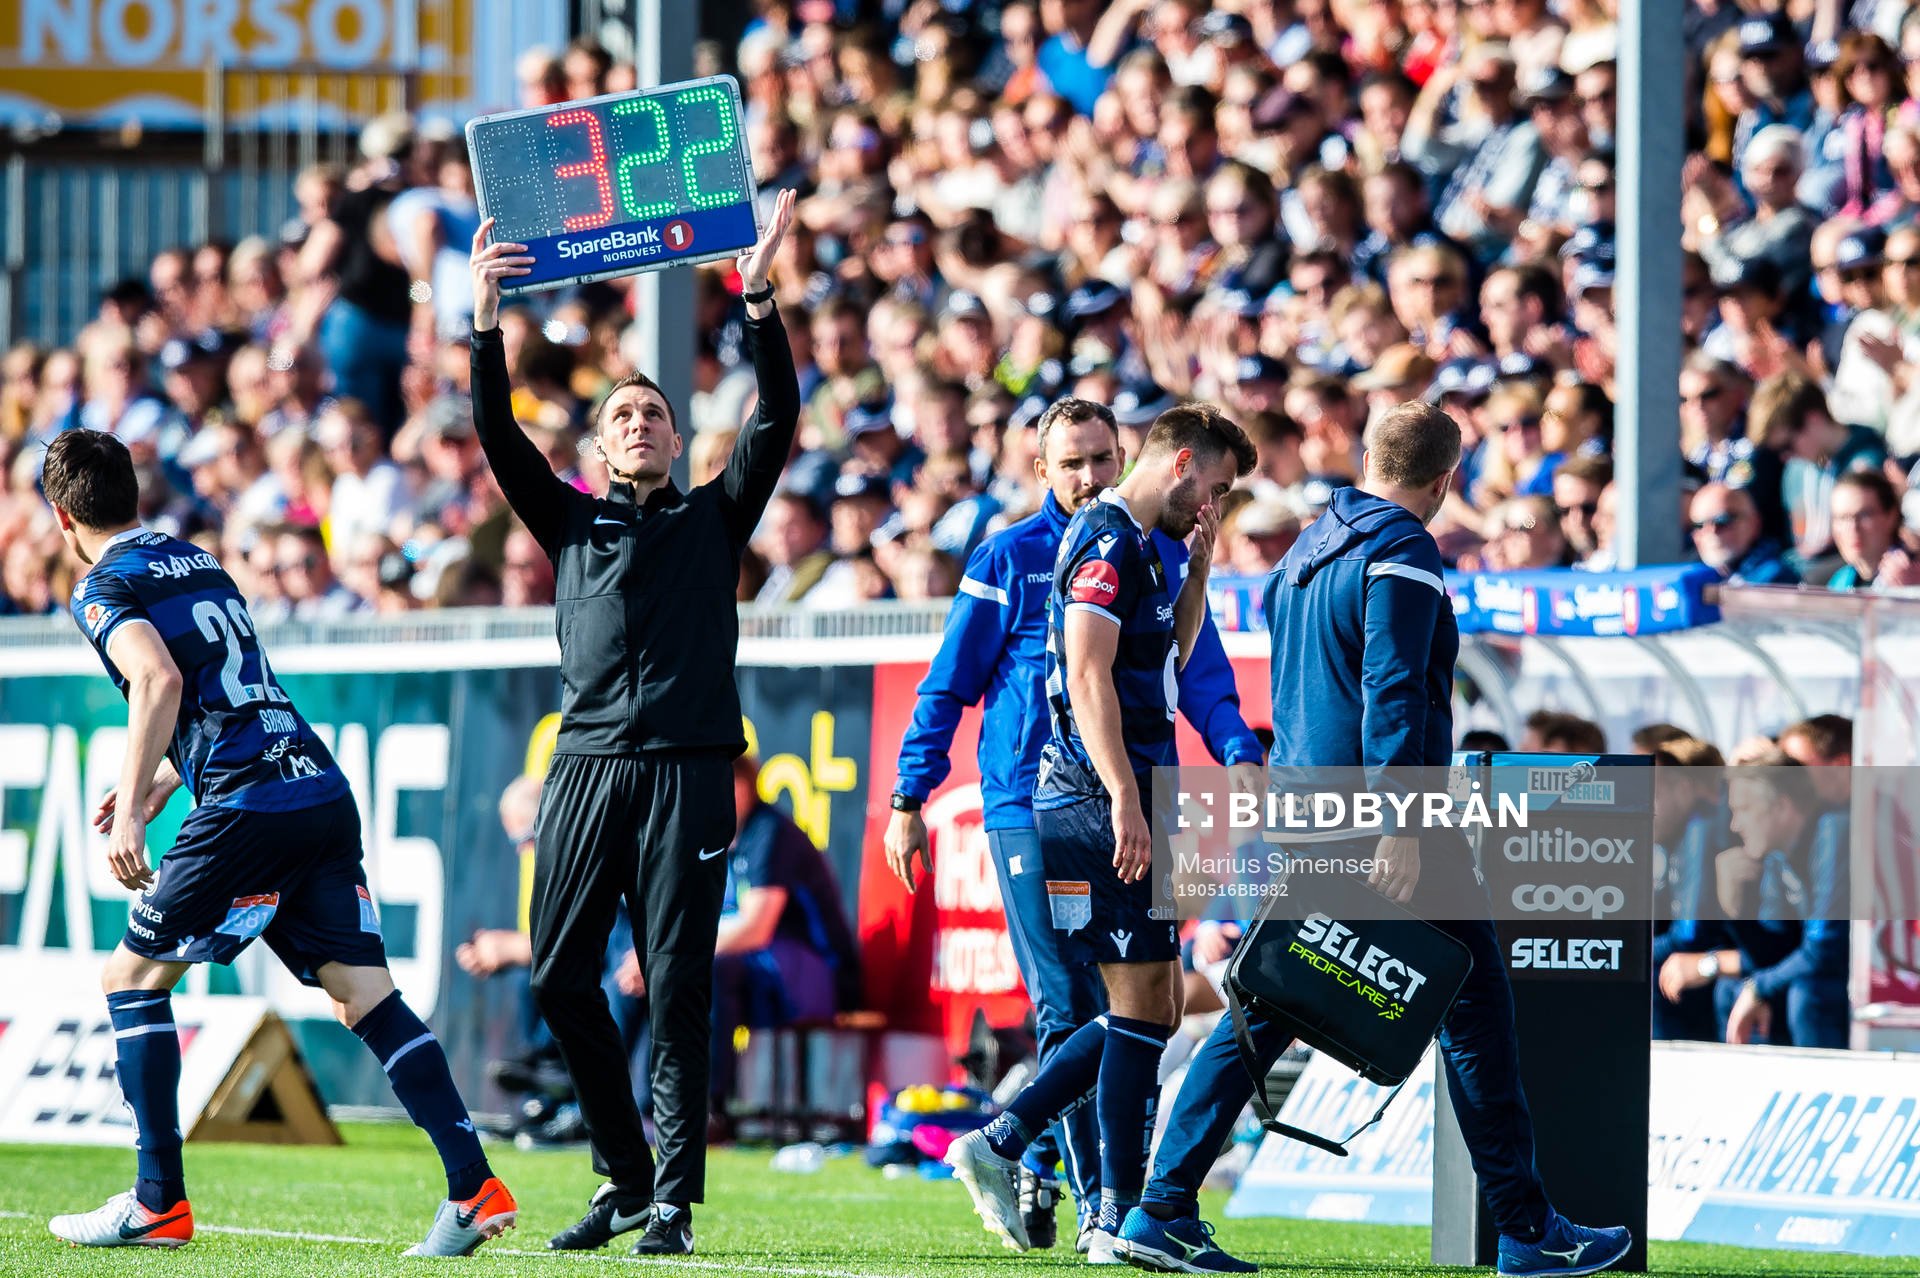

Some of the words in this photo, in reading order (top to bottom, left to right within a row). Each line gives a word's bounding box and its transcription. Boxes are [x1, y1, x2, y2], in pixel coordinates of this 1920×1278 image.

[557, 226, 660, 260] SpareBank
[603, 245, 663, 263] NORDVEST
[1027, 572, 1054, 584] mac
[192, 599, 290, 708] 22
[1531, 771, 1570, 792] ELITE
[1567, 783, 1611, 801] SERIEN
[1503, 827, 1635, 864] altibox
[1147, 906, 1175, 920] oliv
[1511, 884, 1625, 920] coop
[1297, 912, 1428, 1003] SELECT
[1511, 938, 1624, 971] SELECT
[1288, 942, 1389, 1009] PROFCARE
